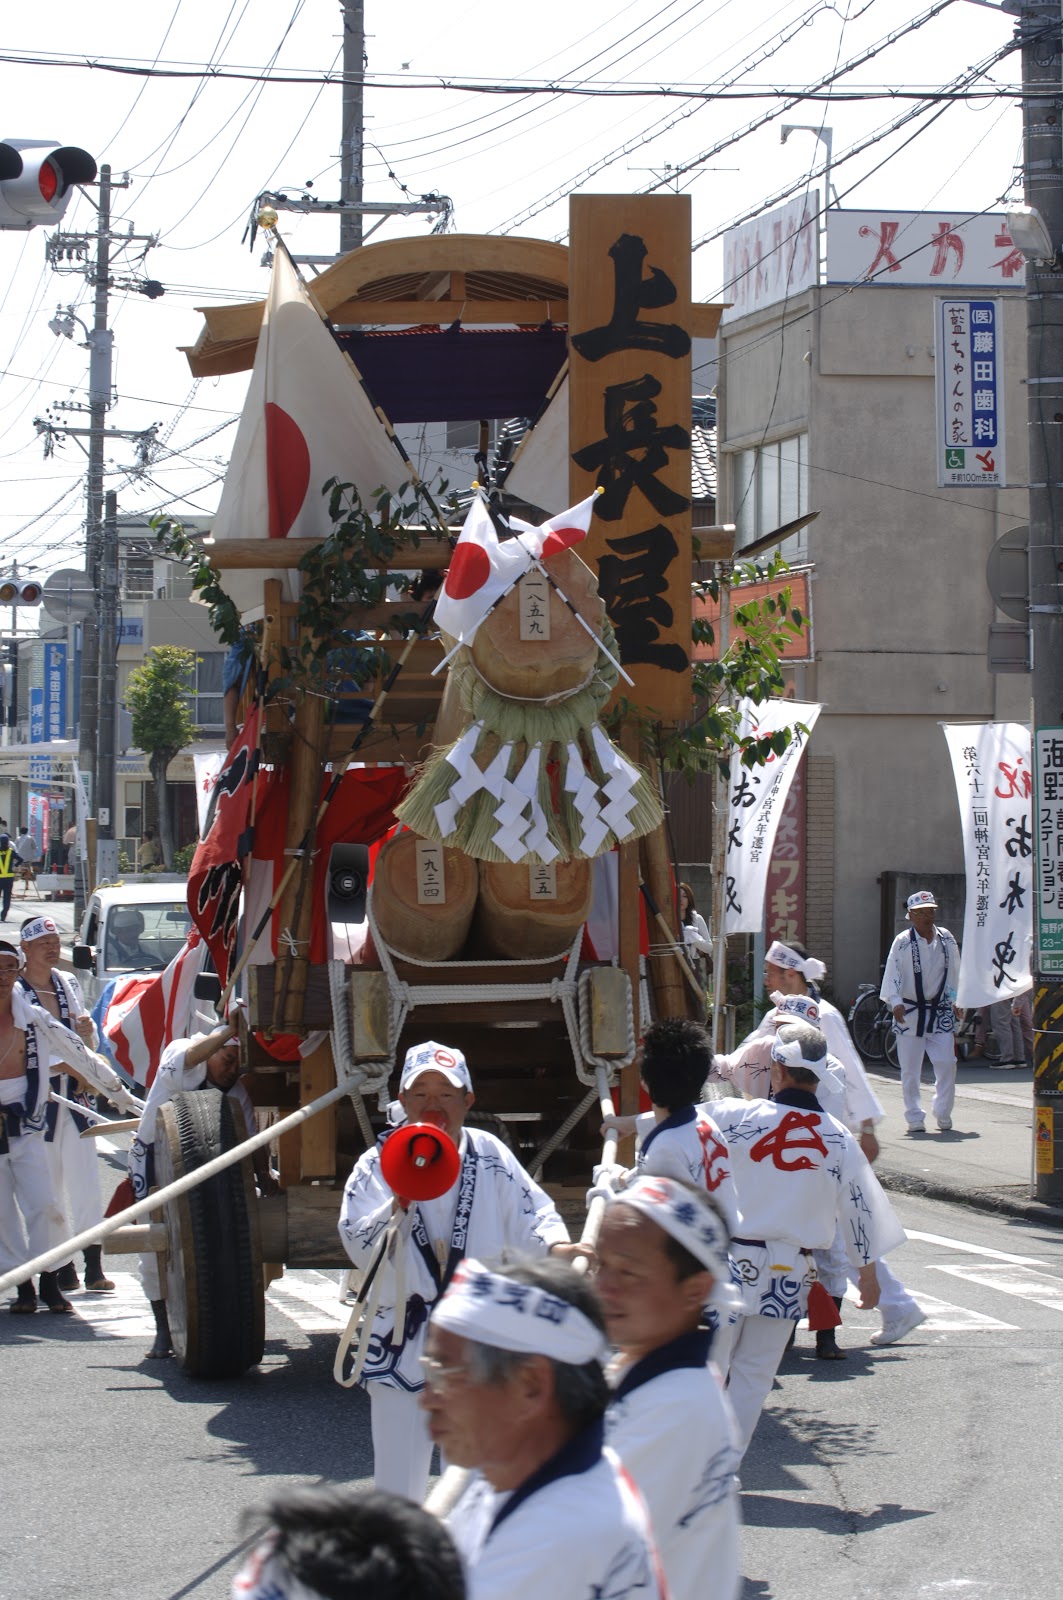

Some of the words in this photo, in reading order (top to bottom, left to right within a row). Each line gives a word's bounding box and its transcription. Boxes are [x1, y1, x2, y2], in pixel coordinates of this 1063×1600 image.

[948, 307, 967, 443] 藍ちゃんの家
[570, 232, 692, 673] 上長屋
[951, 473, 999, 482] 手前100m先左折
[525, 583, 545, 634] 一八五九
[50, 670, 60, 741] 池田耳鼻咽喉
[420, 849, 440, 897] 一九三四
[1041, 808, 1055, 904] ステーション
